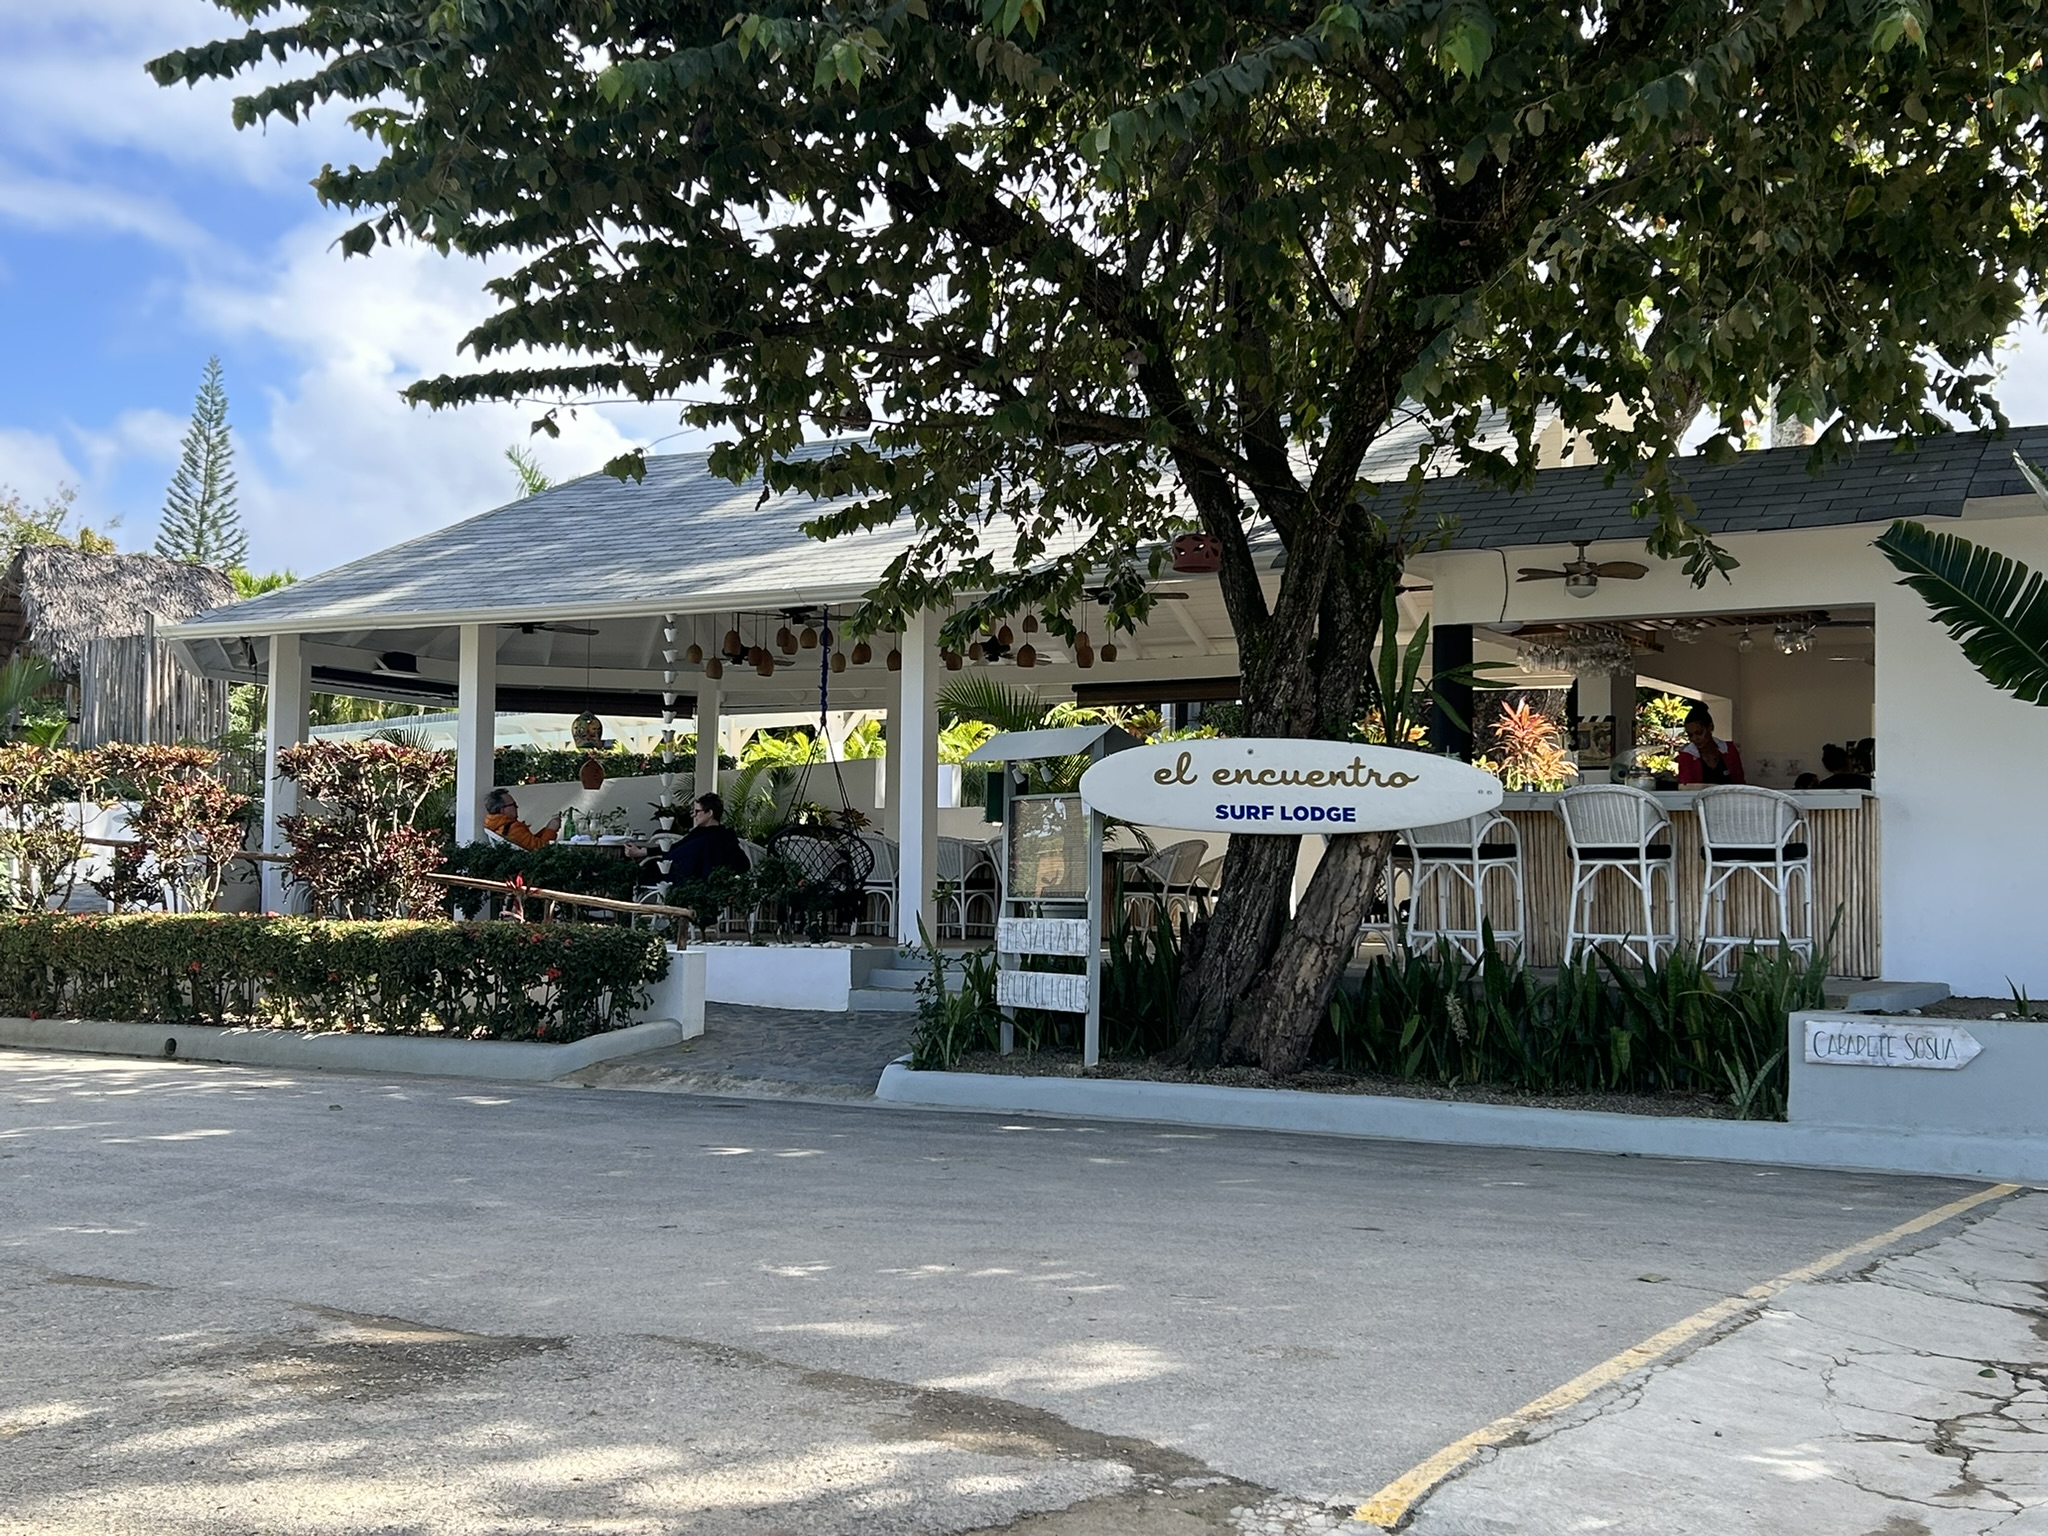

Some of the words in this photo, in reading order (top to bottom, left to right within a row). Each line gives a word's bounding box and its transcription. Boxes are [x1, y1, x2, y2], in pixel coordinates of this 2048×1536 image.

[1154, 751, 1197, 785] el
[1212, 756, 1420, 788] encuentro
[1215, 804, 1274, 821] SURF
[1280, 806, 1356, 823] LODGE
[1813, 1031, 1898, 1059] CABARETE
[1904, 1032, 1958, 1061] SOSUA
